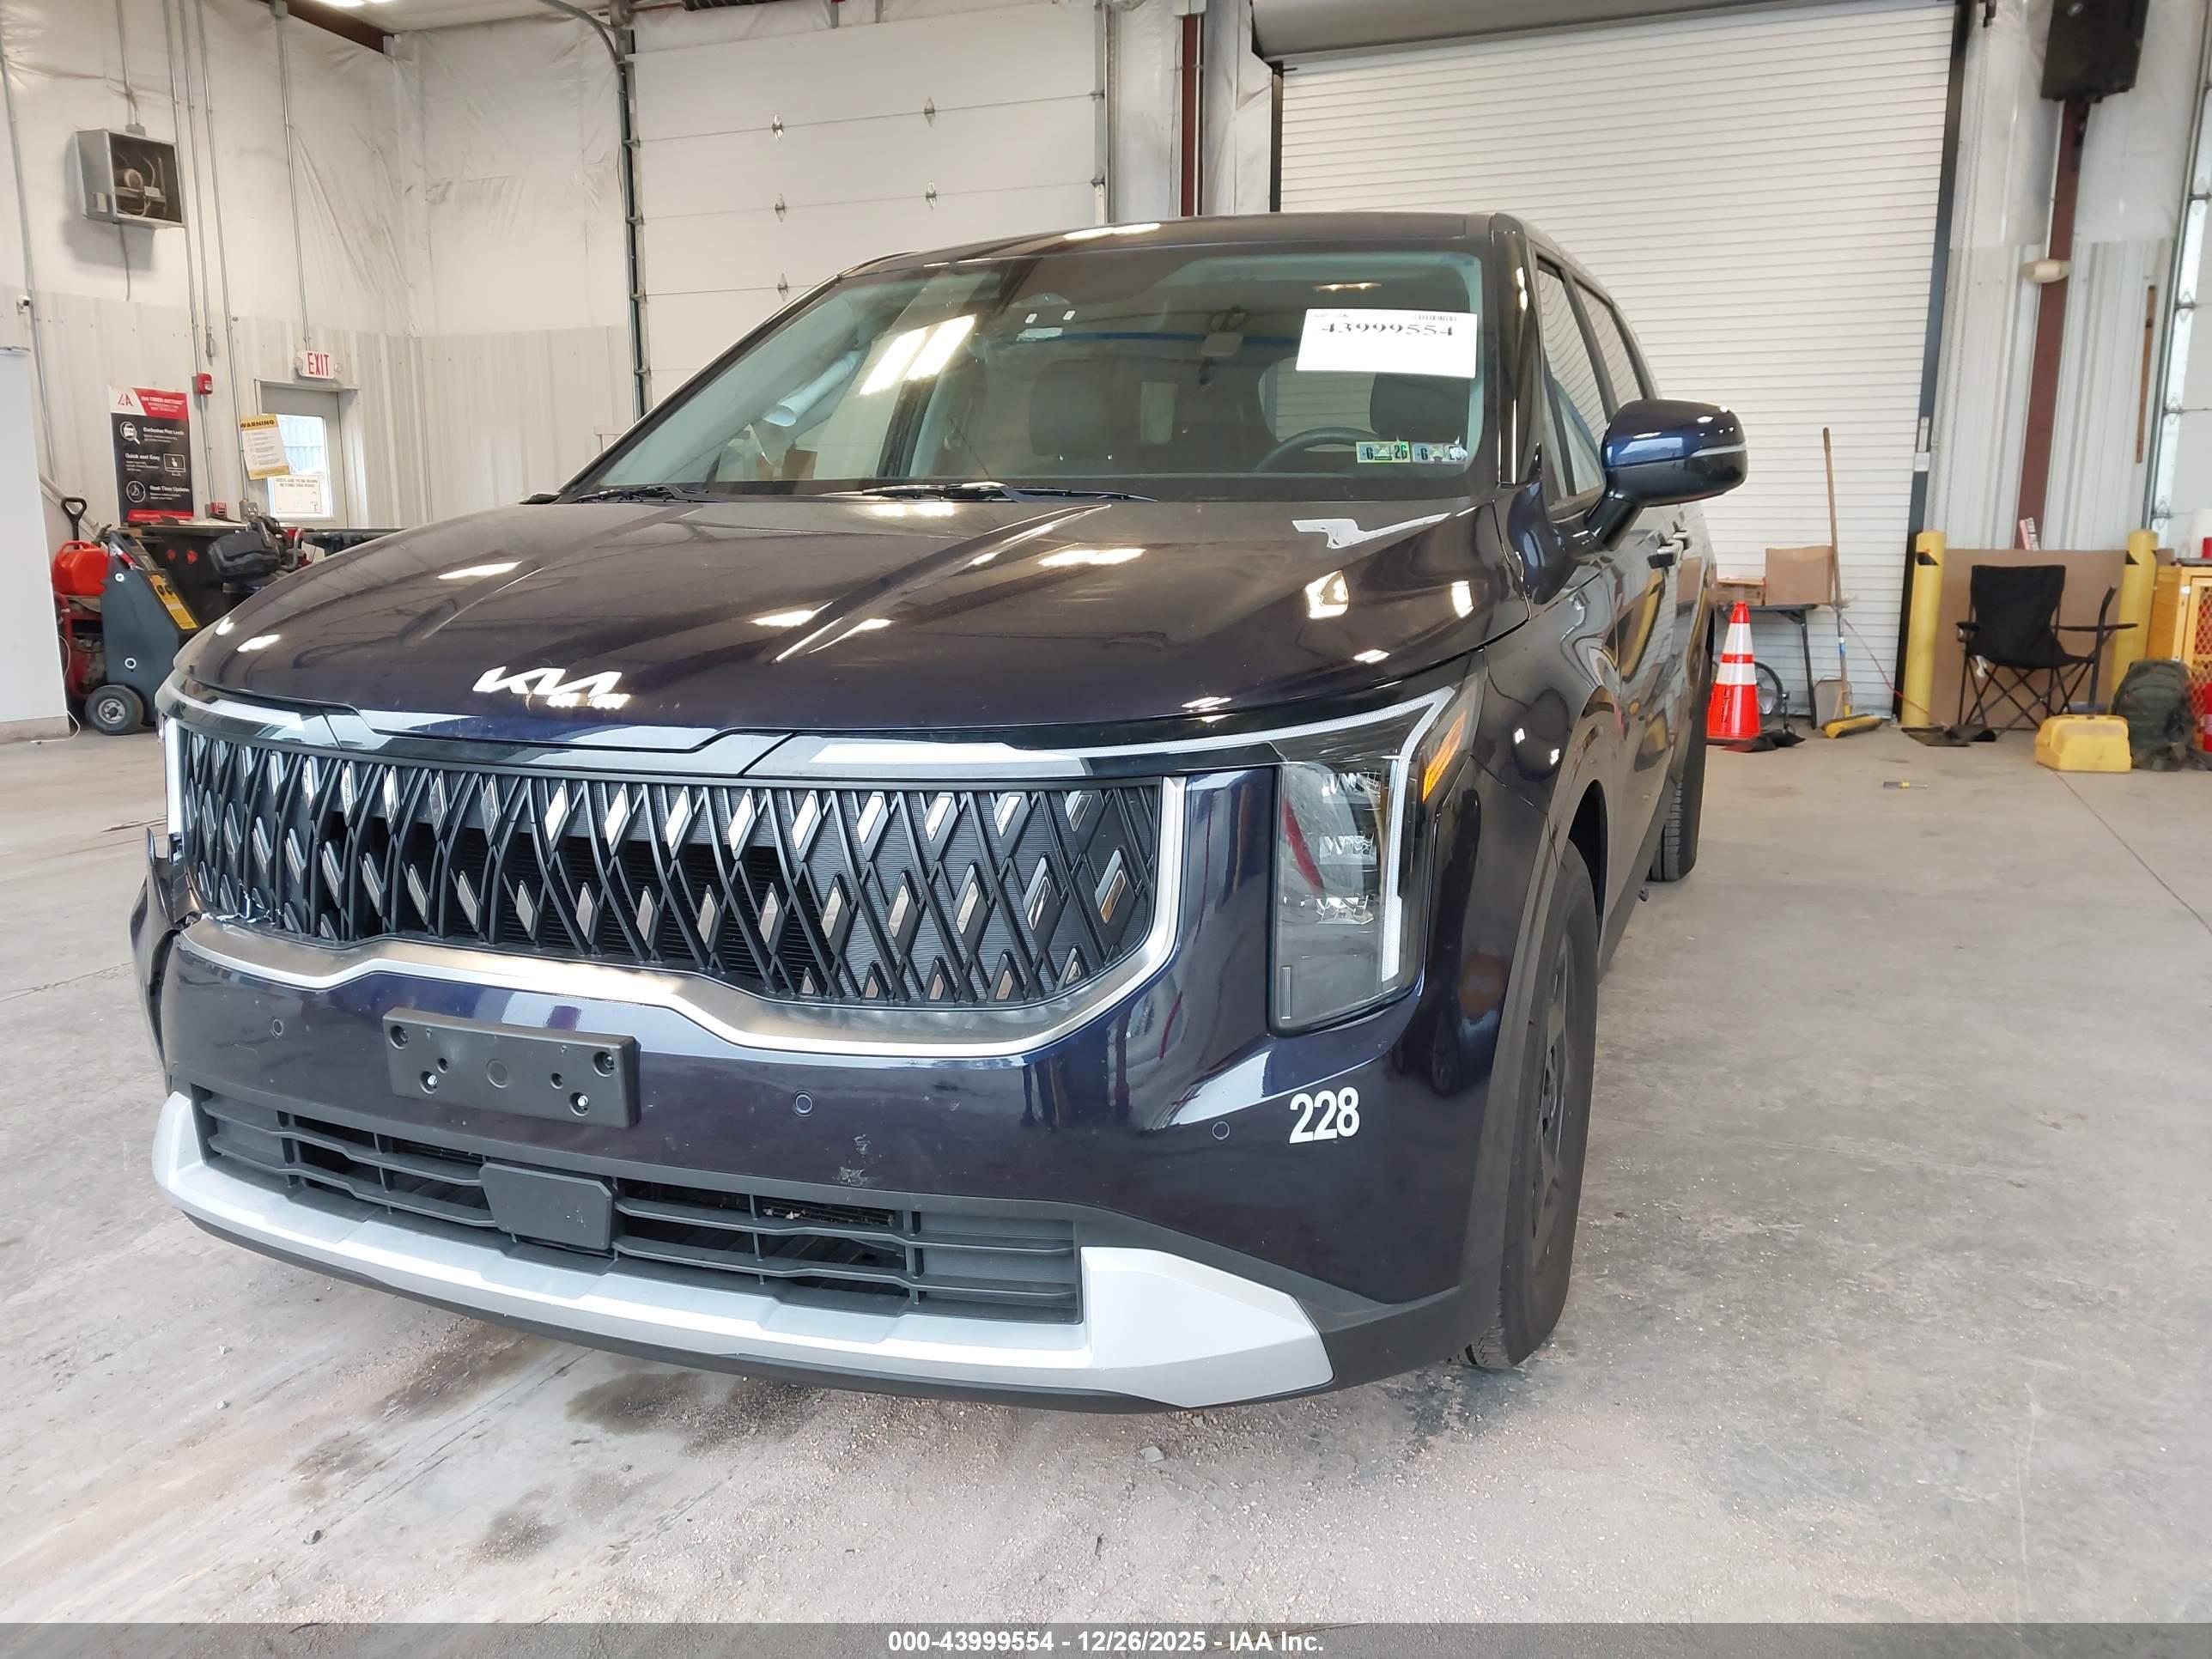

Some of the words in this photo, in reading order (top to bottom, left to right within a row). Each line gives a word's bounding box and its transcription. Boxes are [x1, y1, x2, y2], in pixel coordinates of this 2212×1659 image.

[1322, 322, 1453, 337] 43999554
[307, 352, 331, 377] EXIT
[240, 419, 275, 429] WARNING
[1394, 444, 1408, 459] 26
[1289, 1086, 1360, 1144] 228
